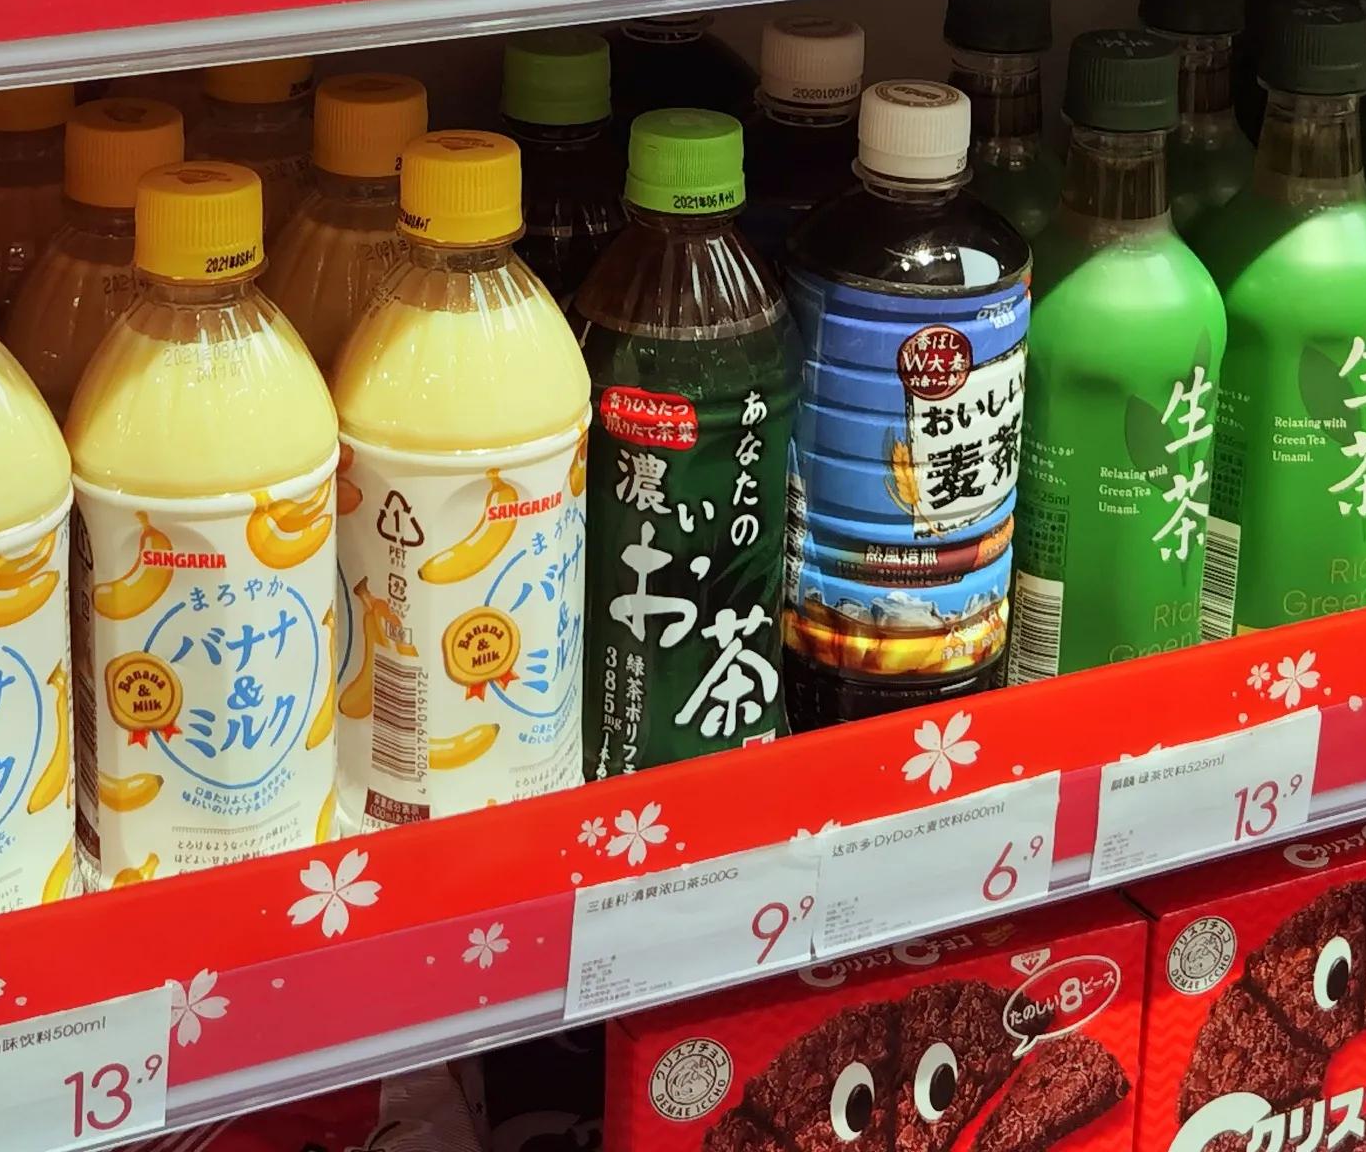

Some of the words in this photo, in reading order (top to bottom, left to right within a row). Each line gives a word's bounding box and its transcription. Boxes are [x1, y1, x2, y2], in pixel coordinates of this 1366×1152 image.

[914, 333, 962, 351] 香ばし
[902, 350, 967, 375] W大麦
[609, 391, 689, 417] 香りひきたつ
[920, 374, 1025, 439] おいしい
[1274, 415, 1320, 430] Relaxing
[1322, 417, 1347, 431] with
[1272, 449, 1314, 463] Umami.
[1273, 432, 1304, 447] Green
[1305, 433, 1326, 448] Tea
[730, 390, 768, 547] あなたの
[925, 413, 1022, 510] 麦茶
[1150, 365, 1215, 562] 生茶
[616, 449, 715, 533] 濃い
[142, 549, 227, 570] SANGARIA
[388, 545, 408, 559] PET
[188, 574, 284, 611] まろやか
[458, 621, 506, 651] Banana
[556, 601, 571, 638] &
[169, 610, 299, 673] バナナ
[471, 651, 501, 669] Milk
[118, 669, 166, 694] Banana
[232, 675, 264, 711] &
[131, 697, 163, 715] Milk
[184, 694, 296, 759] ミルク
[1233, 773, 1303, 842] 13.9
[981, 834, 1044, 902] 6.9
[751, 894, 815, 965] 9.9
[1172, 918, 1233, 958] クリスプチョコ
[1008, 970, 1118, 1030] たのしい8ピース
[653, 1042, 729, 1084] クリスプチョコ
[64, 1053, 163, 1138] 13.9
[655, 1090, 696, 1119] DEMAE
[695, 1079, 727, 1114] ICCHO
